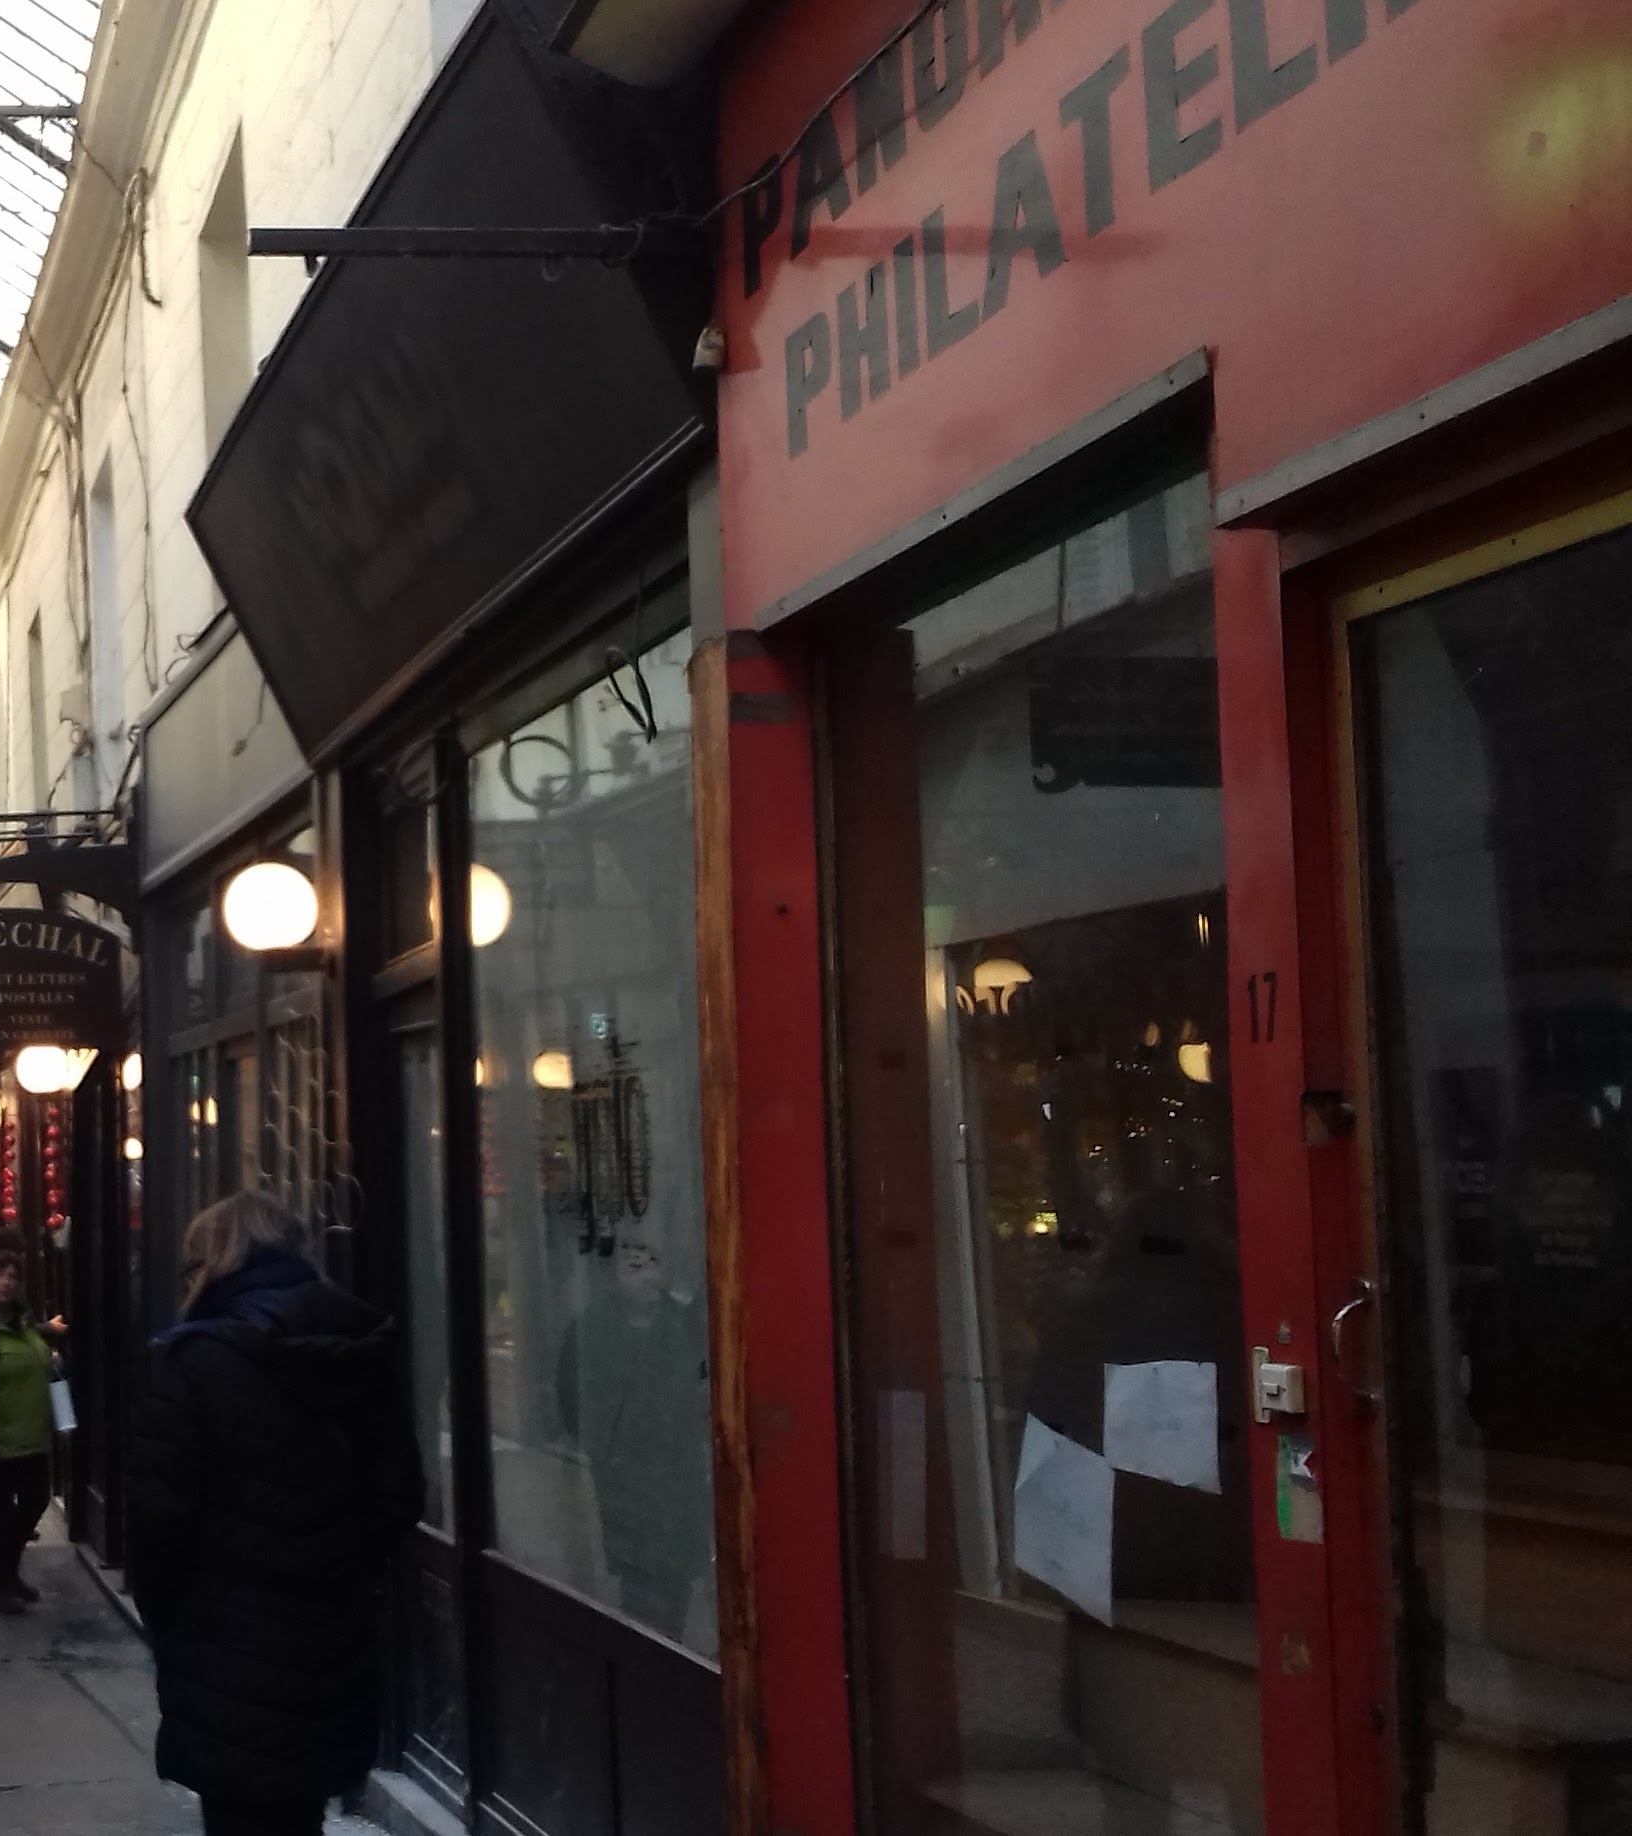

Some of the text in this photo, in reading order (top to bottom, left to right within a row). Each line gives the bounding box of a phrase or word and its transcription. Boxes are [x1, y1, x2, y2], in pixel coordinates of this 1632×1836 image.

[741, 0, 1074, 299] PANO
[785, 0, 1419, 460] PHILATEL
[18, 972, 87, 986] LETTRES
[1247, 971, 1278, 1043] 17
